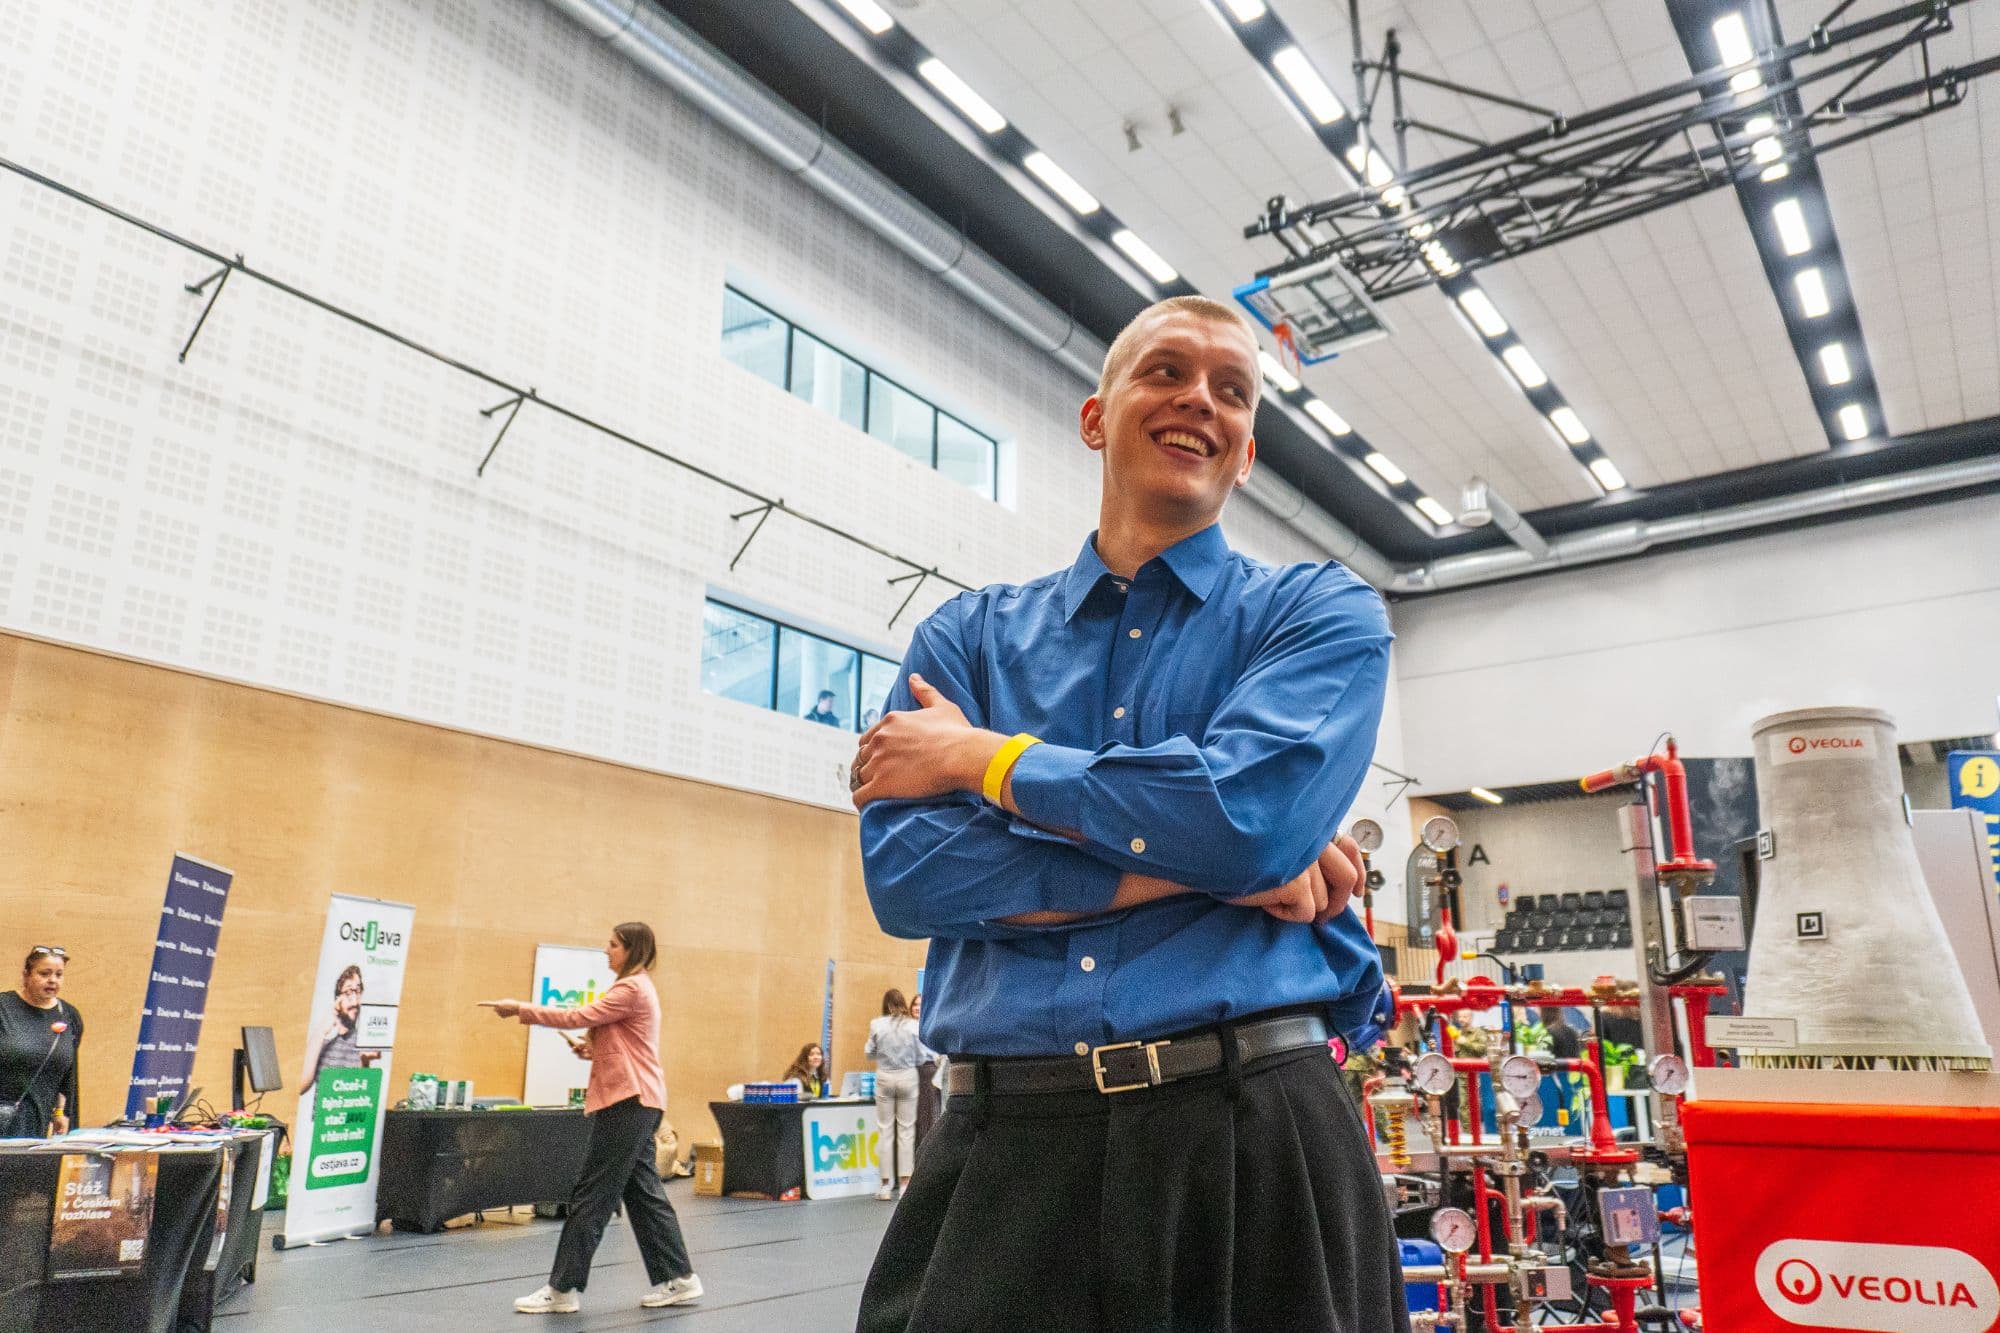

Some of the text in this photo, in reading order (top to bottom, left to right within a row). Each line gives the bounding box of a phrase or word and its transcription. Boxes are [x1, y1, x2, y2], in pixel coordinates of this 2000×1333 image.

[1809, 738, 1863, 749] VEOLIA
[1468, 844, 1490, 866] A
[64, 1181, 103, 1196] Stáž
[1829, 1274, 1978, 1309] VEOLIA
